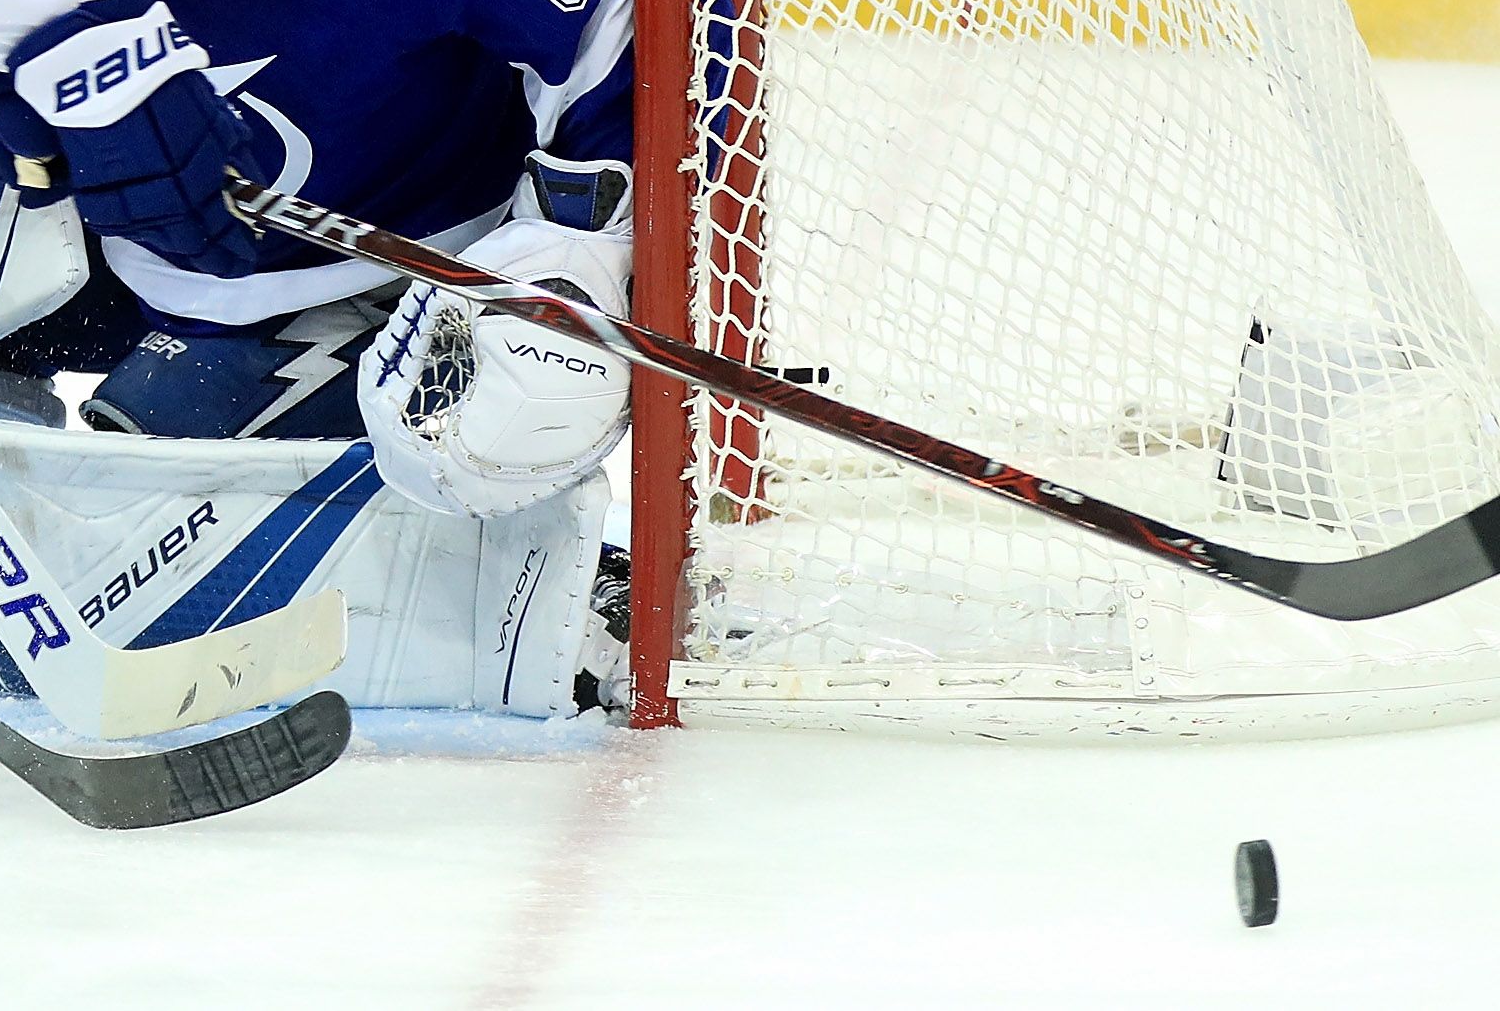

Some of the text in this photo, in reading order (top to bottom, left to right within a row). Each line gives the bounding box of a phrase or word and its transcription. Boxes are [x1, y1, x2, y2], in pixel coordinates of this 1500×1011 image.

[55, 20, 190, 113] BAUE
[236, 179, 376, 250] UER
[137, 331, 188, 361] UER
[502, 336, 610, 382] VAPOR
[494, 546, 543, 654] VAPOR
